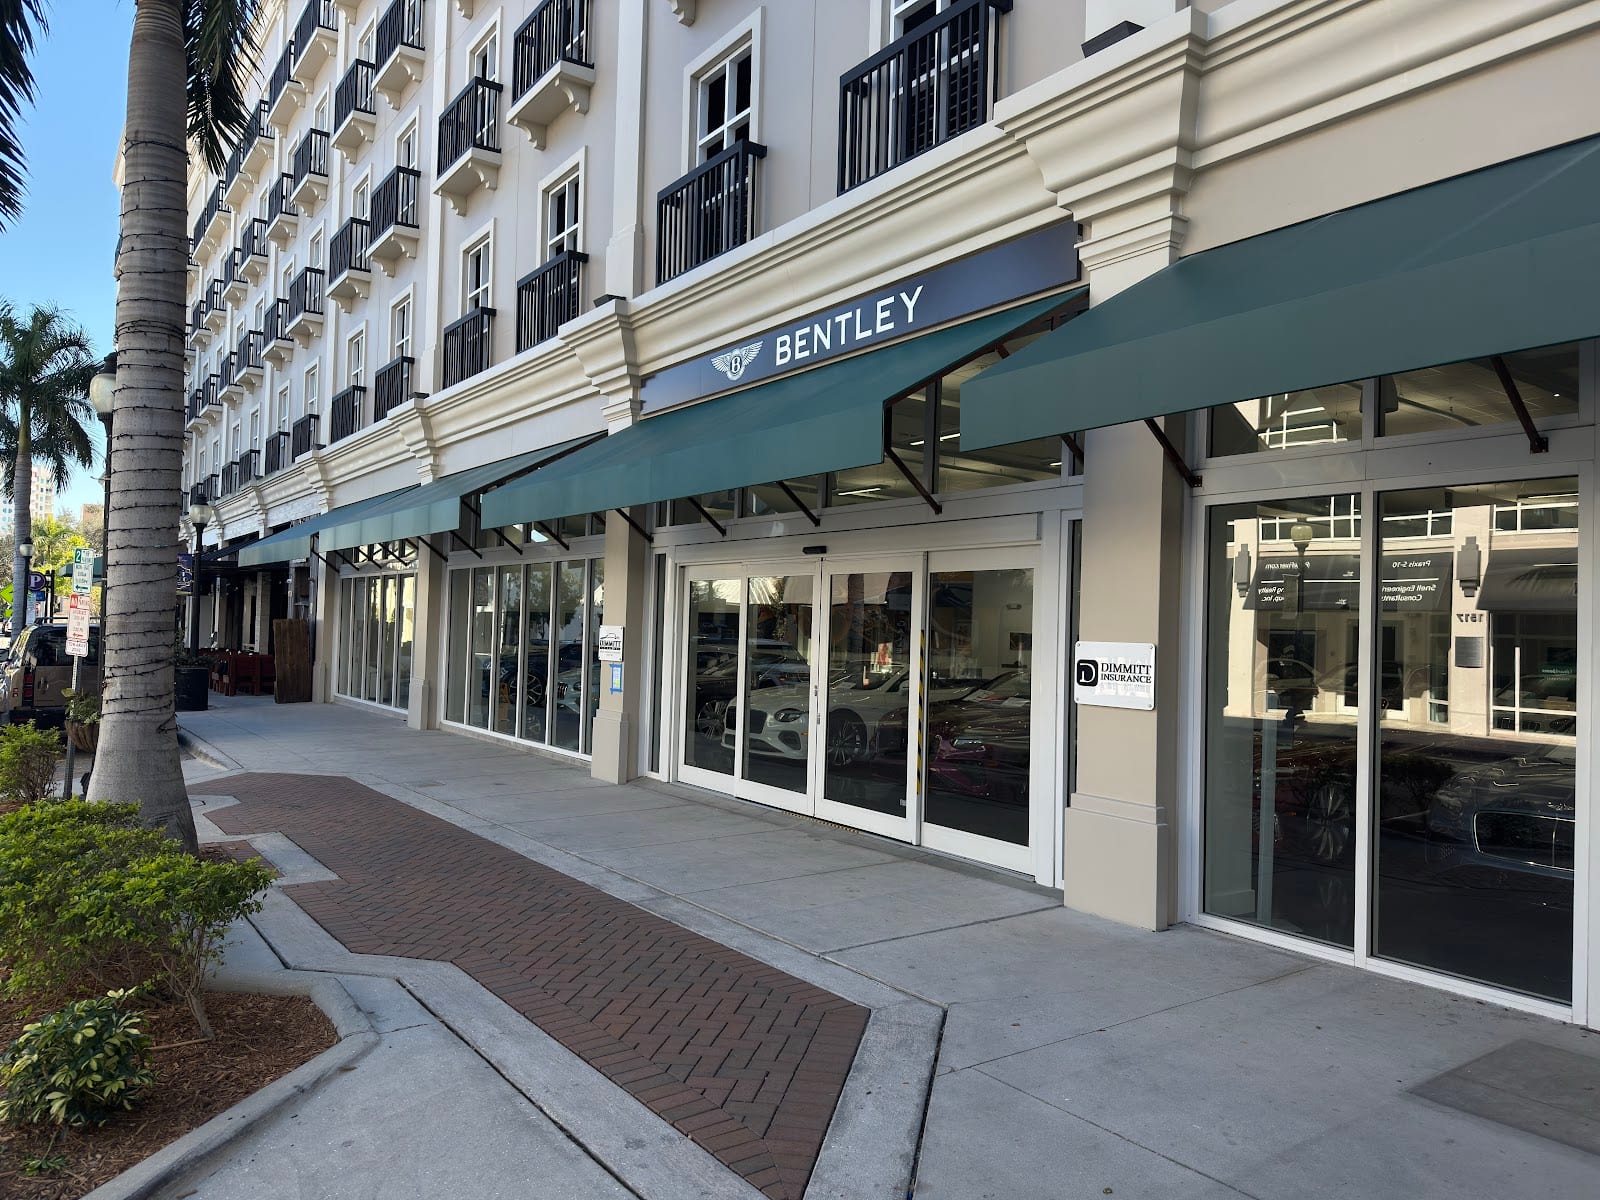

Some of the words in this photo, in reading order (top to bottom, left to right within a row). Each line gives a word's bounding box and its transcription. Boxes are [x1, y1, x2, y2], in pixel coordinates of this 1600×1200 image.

[775, 285, 924, 366] BENTLEY
[30, 574, 41, 588] P
[1101, 663, 1152, 675] DIMMITT
[1101, 673, 1152, 684] INSURANCE
